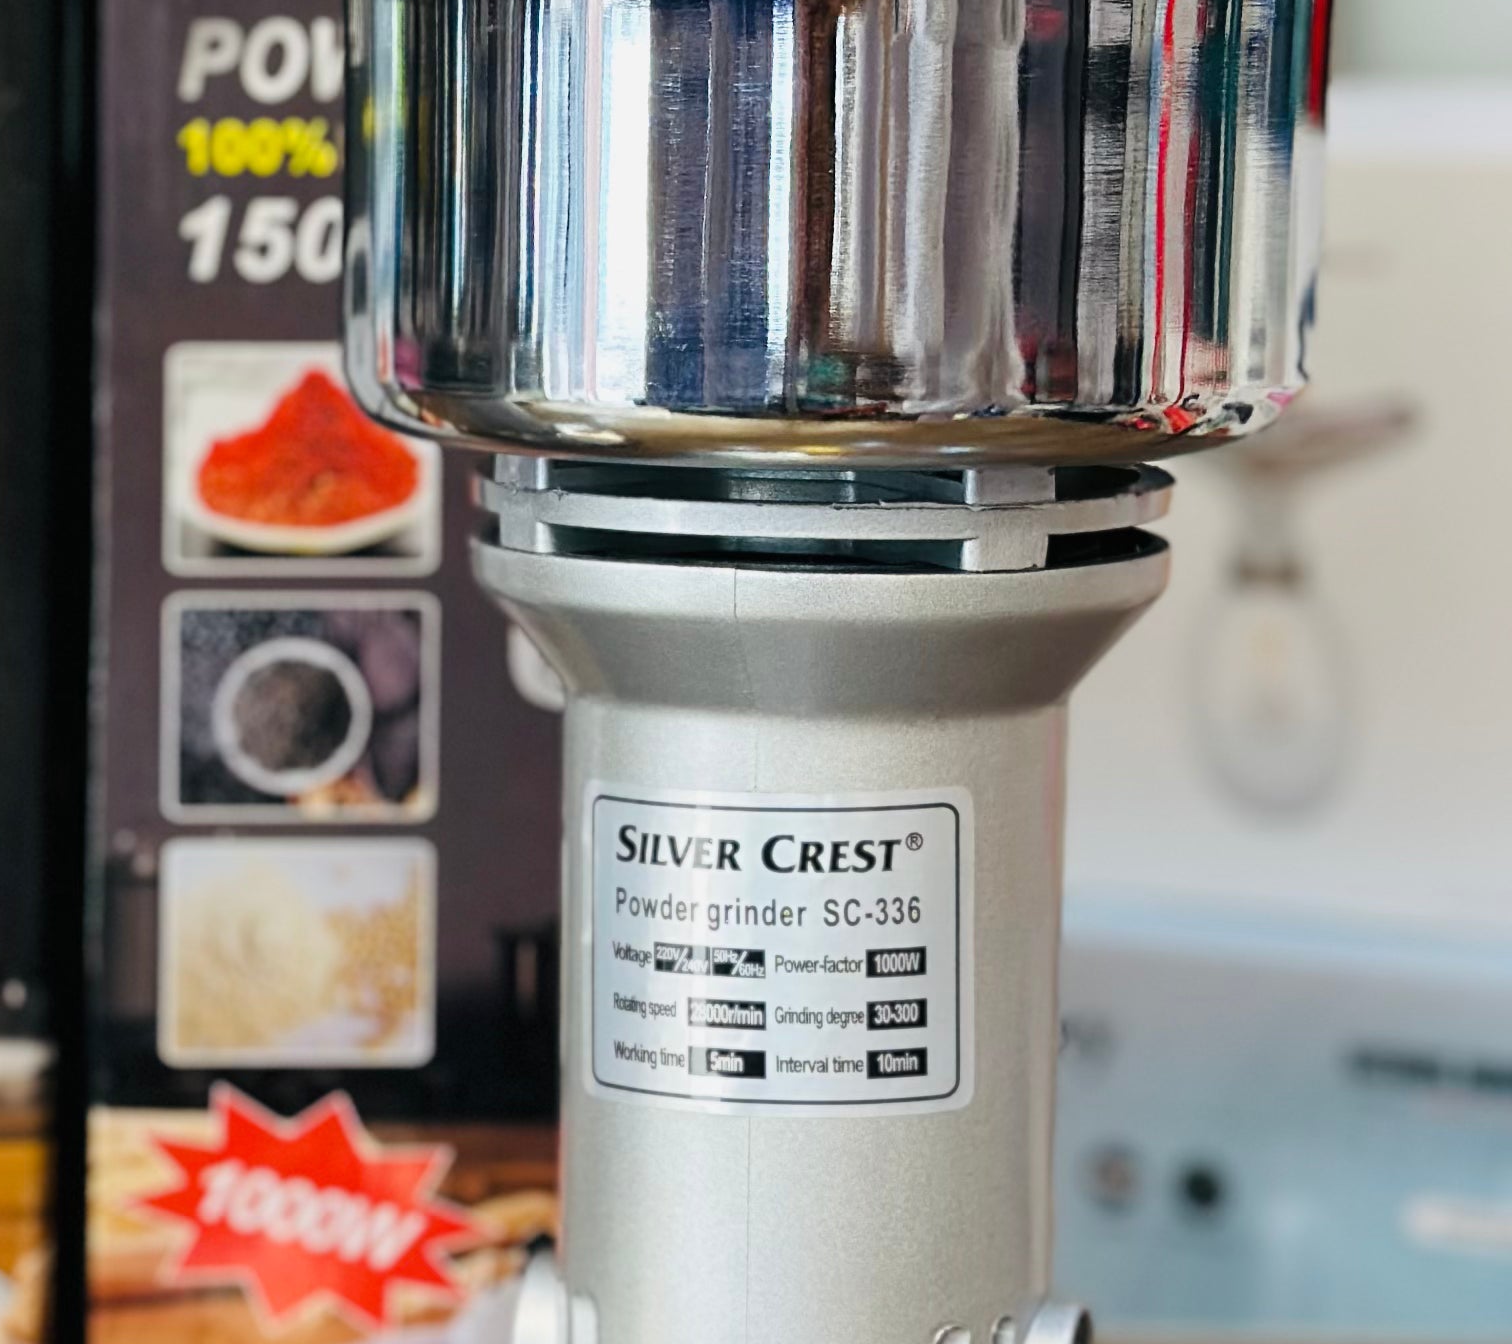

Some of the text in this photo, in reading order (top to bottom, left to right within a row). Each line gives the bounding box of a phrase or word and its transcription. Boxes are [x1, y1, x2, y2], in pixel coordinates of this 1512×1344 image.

[176, 115, 338, 177] 100%
[615, 824, 743, 872] SILVER
[615, 886, 922, 931] Powder grinder SC-336
[612, 940, 653, 966] Voltage
[774, 955, 864, 975] Power-factor
[873, 952, 920, 973] 1000W
[613, 992, 647, 1018] Rotating
[648, 999, 678, 1021] speed
[774, 1005, 824, 1029] Grinding
[826, 1005, 865, 1029] degree
[873, 1002, 919, 1025] 30-300
[613, 1039, 919, 1075] Working time 5min Interval time 10min
[197, 1158, 429, 1272] 1000W
